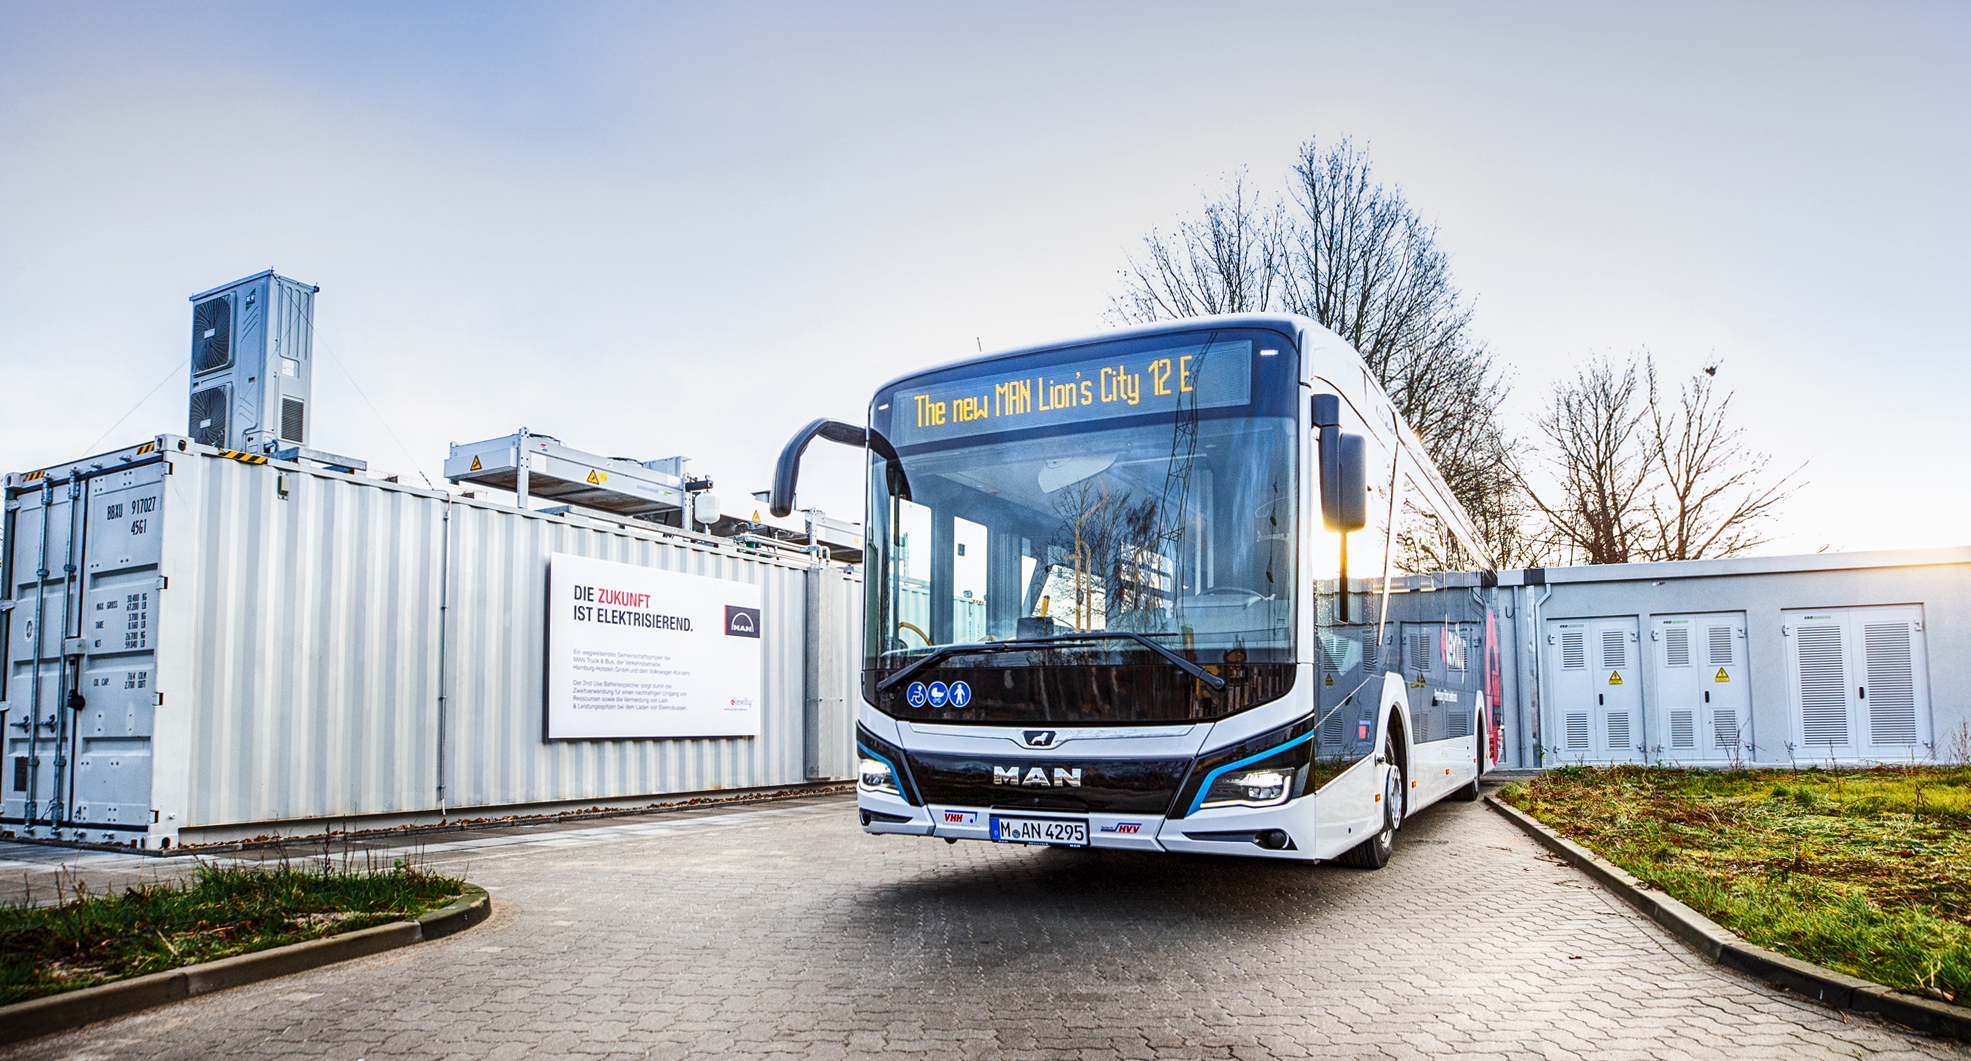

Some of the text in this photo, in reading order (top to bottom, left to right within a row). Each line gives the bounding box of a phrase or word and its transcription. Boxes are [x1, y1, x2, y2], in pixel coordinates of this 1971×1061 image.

[914, 355, 1194, 428] The new MAN Lion's City 12 E
[107, 496, 156, 520] BBXU 917027
[130, 518, 147, 536] 45G1
[574, 585, 651, 609] DIE ZUKUNFT
[107, 600, 119, 610] GROSS
[574, 605, 694, 632] IST ELEKTRISIEREND.
[733, 624, 752, 632] MAN
[586, 656, 600, 664] Truck
[582, 679, 592, 687] 2nd
[573, 694, 601, 702] Ressourcen
[993, 766, 1082, 788] MAN
[944, 813, 963, 823] VHH
[1000, 821, 1011, 838] M
[1021, 822, 1042, 839] AN
[1045, 823, 1085, 841] 4295
[1118, 824, 1140, 834] HVV
